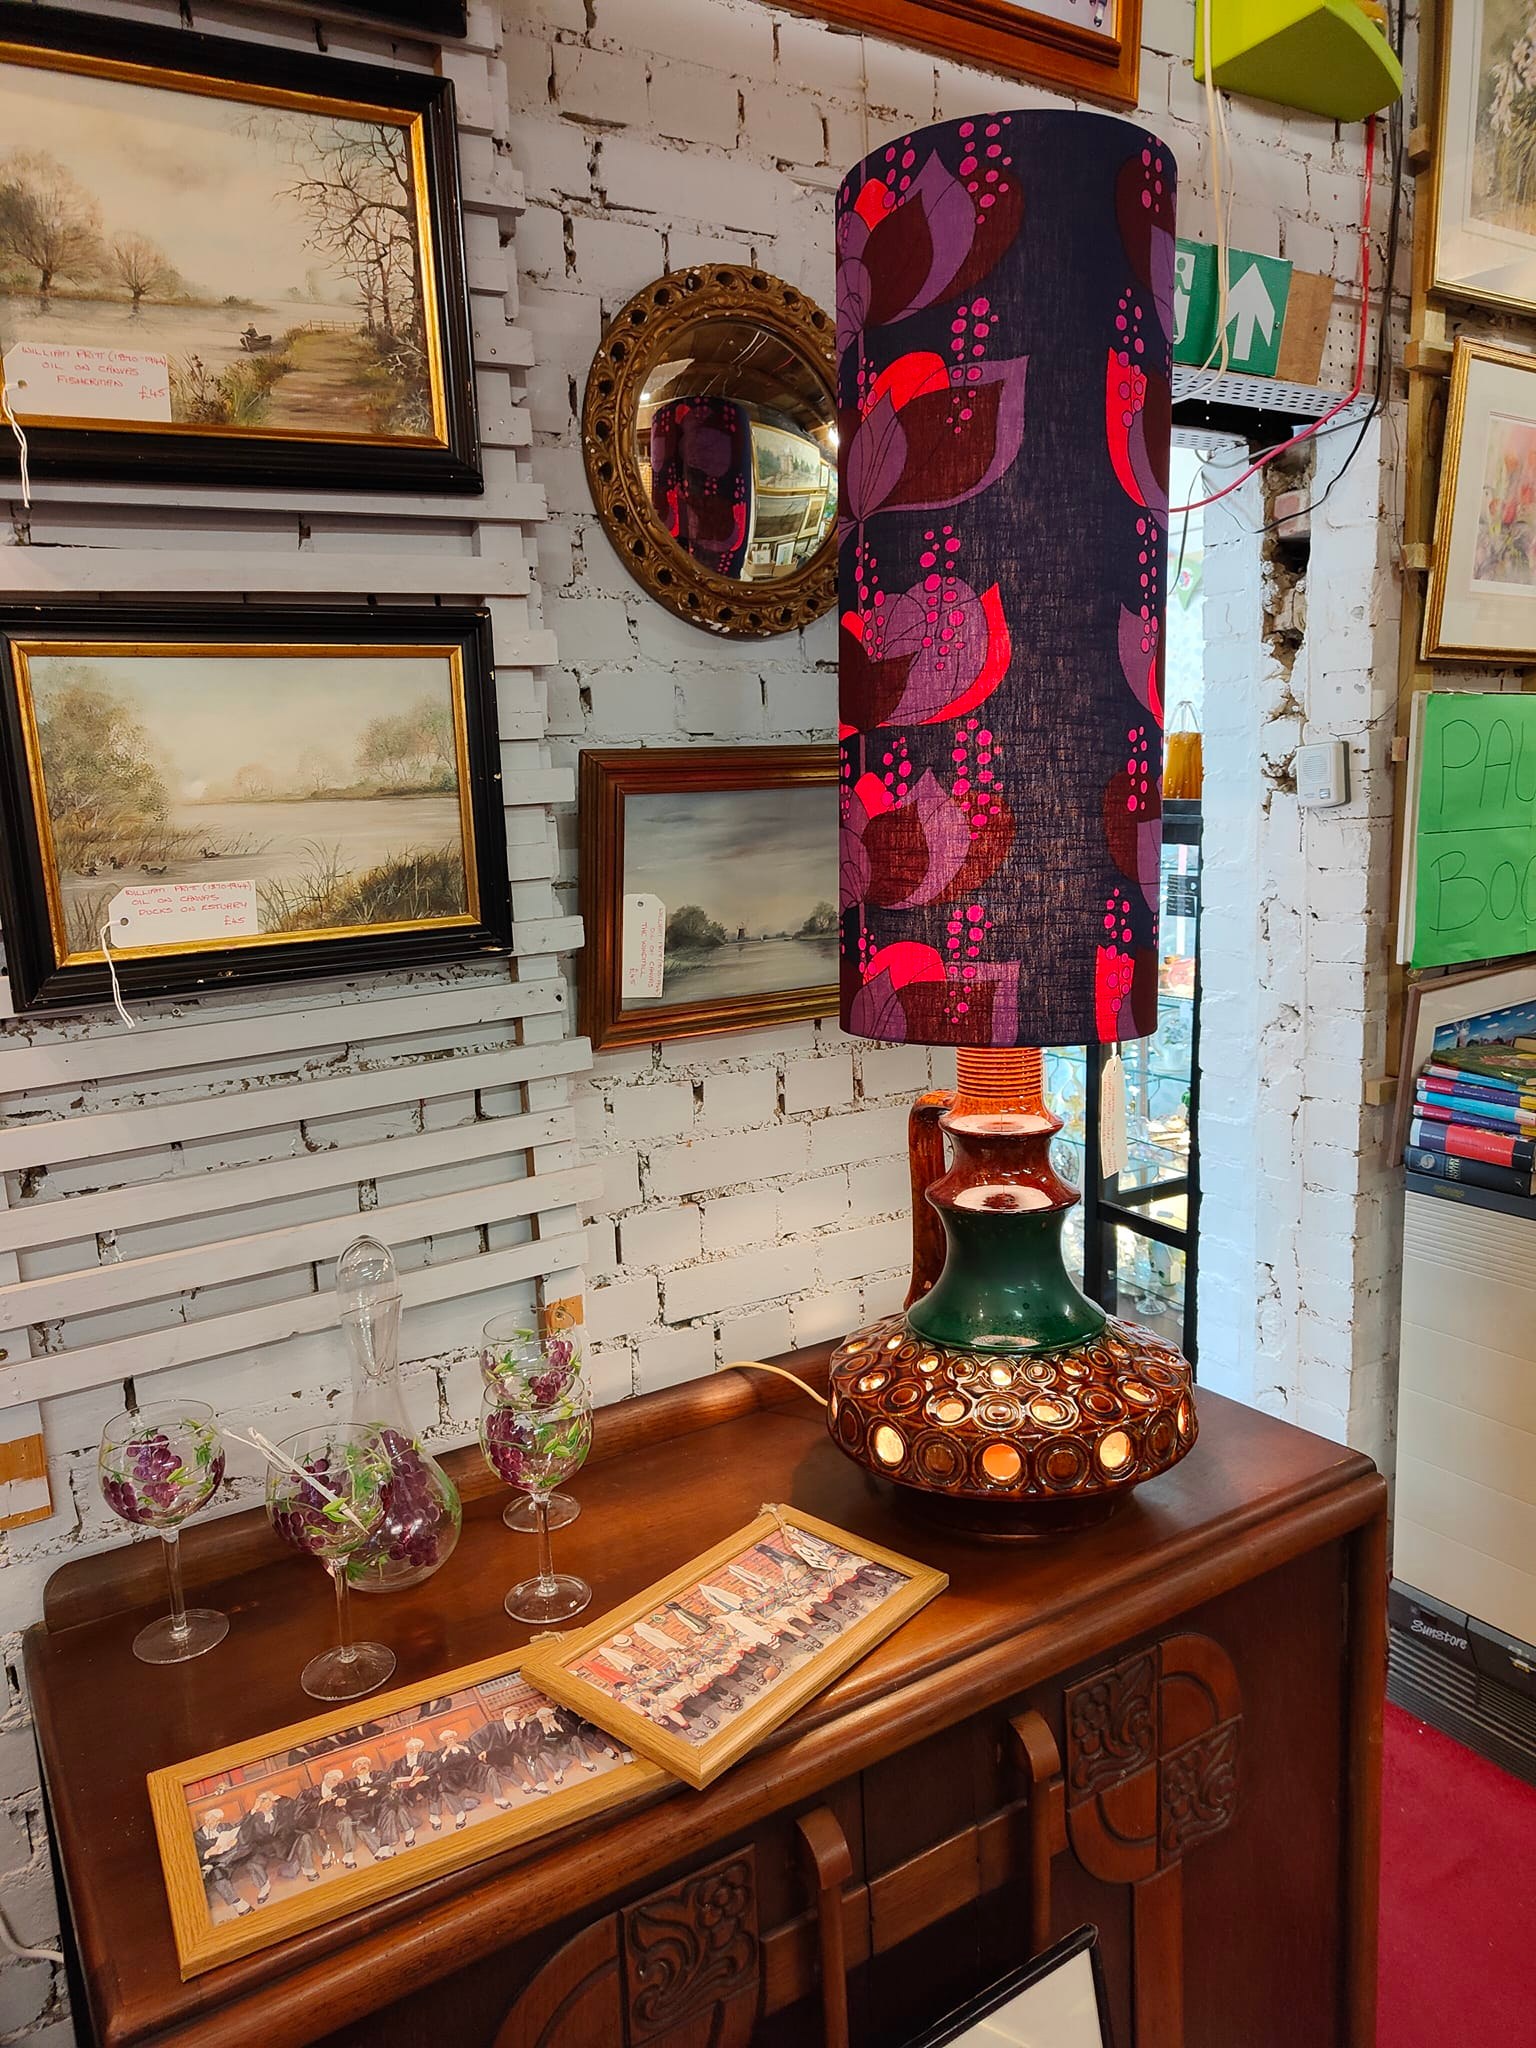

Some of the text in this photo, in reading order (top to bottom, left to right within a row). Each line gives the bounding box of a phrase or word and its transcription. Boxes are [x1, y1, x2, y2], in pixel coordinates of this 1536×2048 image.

[41, 362, 140, 376] OIL ON CANVAS
[56, 375, 124, 388] FISHERMAN
[138, 385, 166, 400] £45
[157, 896, 173, 904] ON
[138, 907, 174, 916] DUCKS
[180, 905, 196, 913] ON
